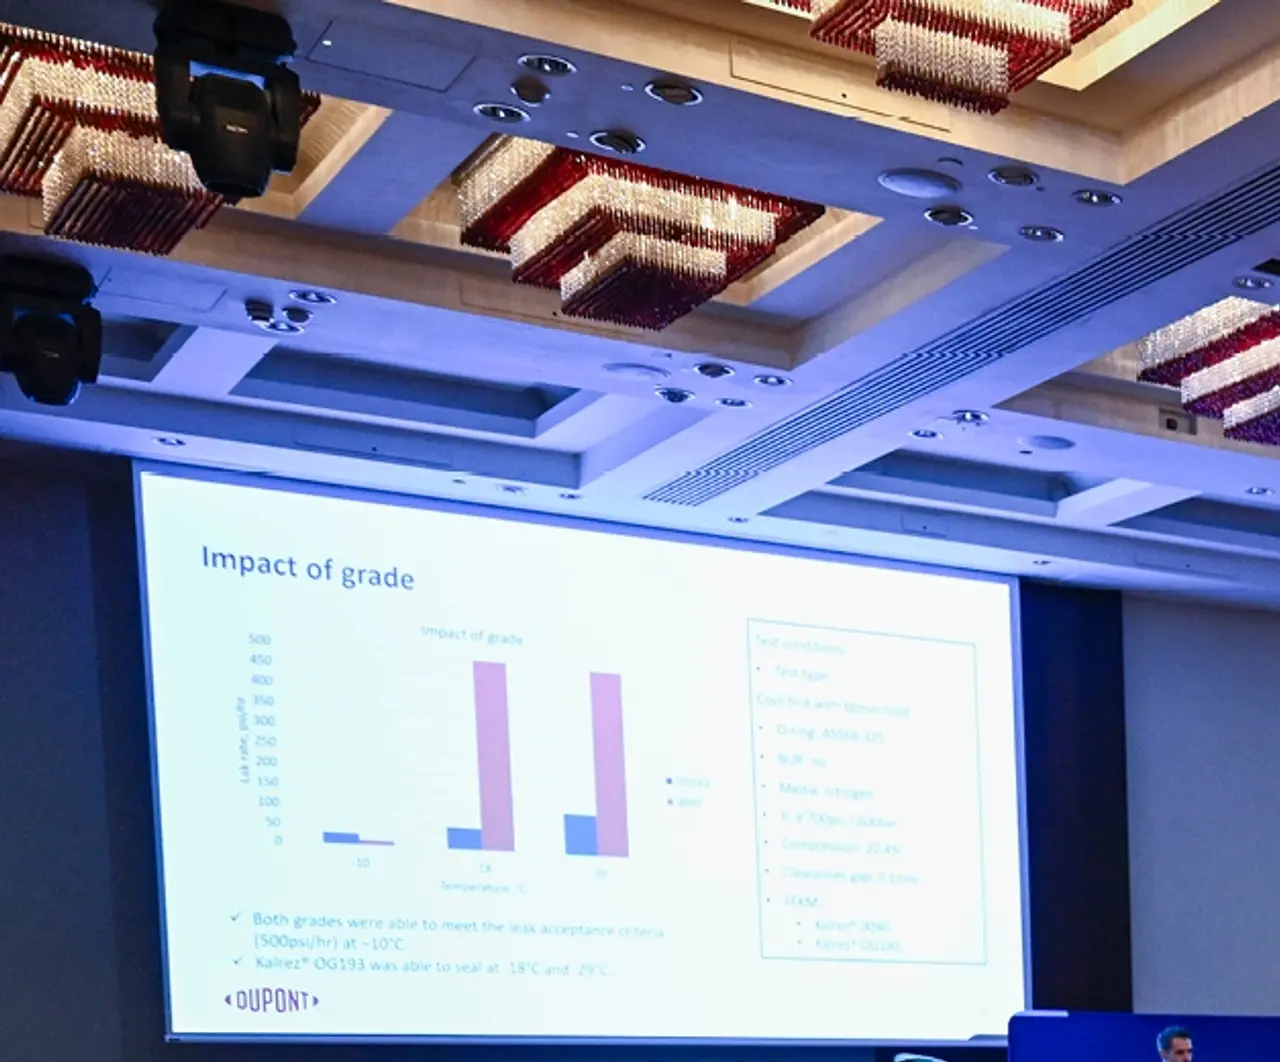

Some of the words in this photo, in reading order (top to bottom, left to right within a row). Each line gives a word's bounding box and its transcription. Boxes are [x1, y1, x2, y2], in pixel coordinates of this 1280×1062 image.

[201, 546, 297, 577] Impact
[306, 558, 333, 580] of
[342, 567, 415, 590] grade
[248, 632, 272, 645] 500
[420, 625, 467, 641] Impact
[471, 630, 485, 642] of
[487, 632, 524, 646] grade
[250, 654, 273, 666] 450
[251, 674, 274, 686] 400
[253, 694, 275, 706] 350
[254, 714, 276, 727] 300
[255, 735, 277, 747] 250
[256, 755, 278, 767] 200
[258, 775, 279, 787] 150
[259, 796, 281, 807] 100
[265, 816, 282, 828] 50
[273, 835, 283, 846] 0
[253, 912, 289, 926] Both
[293, 915, 343, 929] grades
[347, 918, 383, 929] were
[388, 917, 418, 930] able
[422, 919, 437, 931] to
[441, 921, 477, 933] meet
[481, 920, 505, 933] the
[508, 922, 535, 934] leak
[540, 925, 614, 937] acceptance
[617, 925, 665, 938] criteria
[254, 934, 339, 950] (500psi/hr)
[343, 937, 356, 949] at
[314, 957, 365, 970] OG193
[370, 960, 398, 971] was
[402, 959, 431, 972] able
[436, 961, 451, 973] to
[455, 960, 482, 973] seal
[486, 962, 499, 973] at
[545, 963, 569, 976] and
[236, 987, 309, 1013] DUPONT
